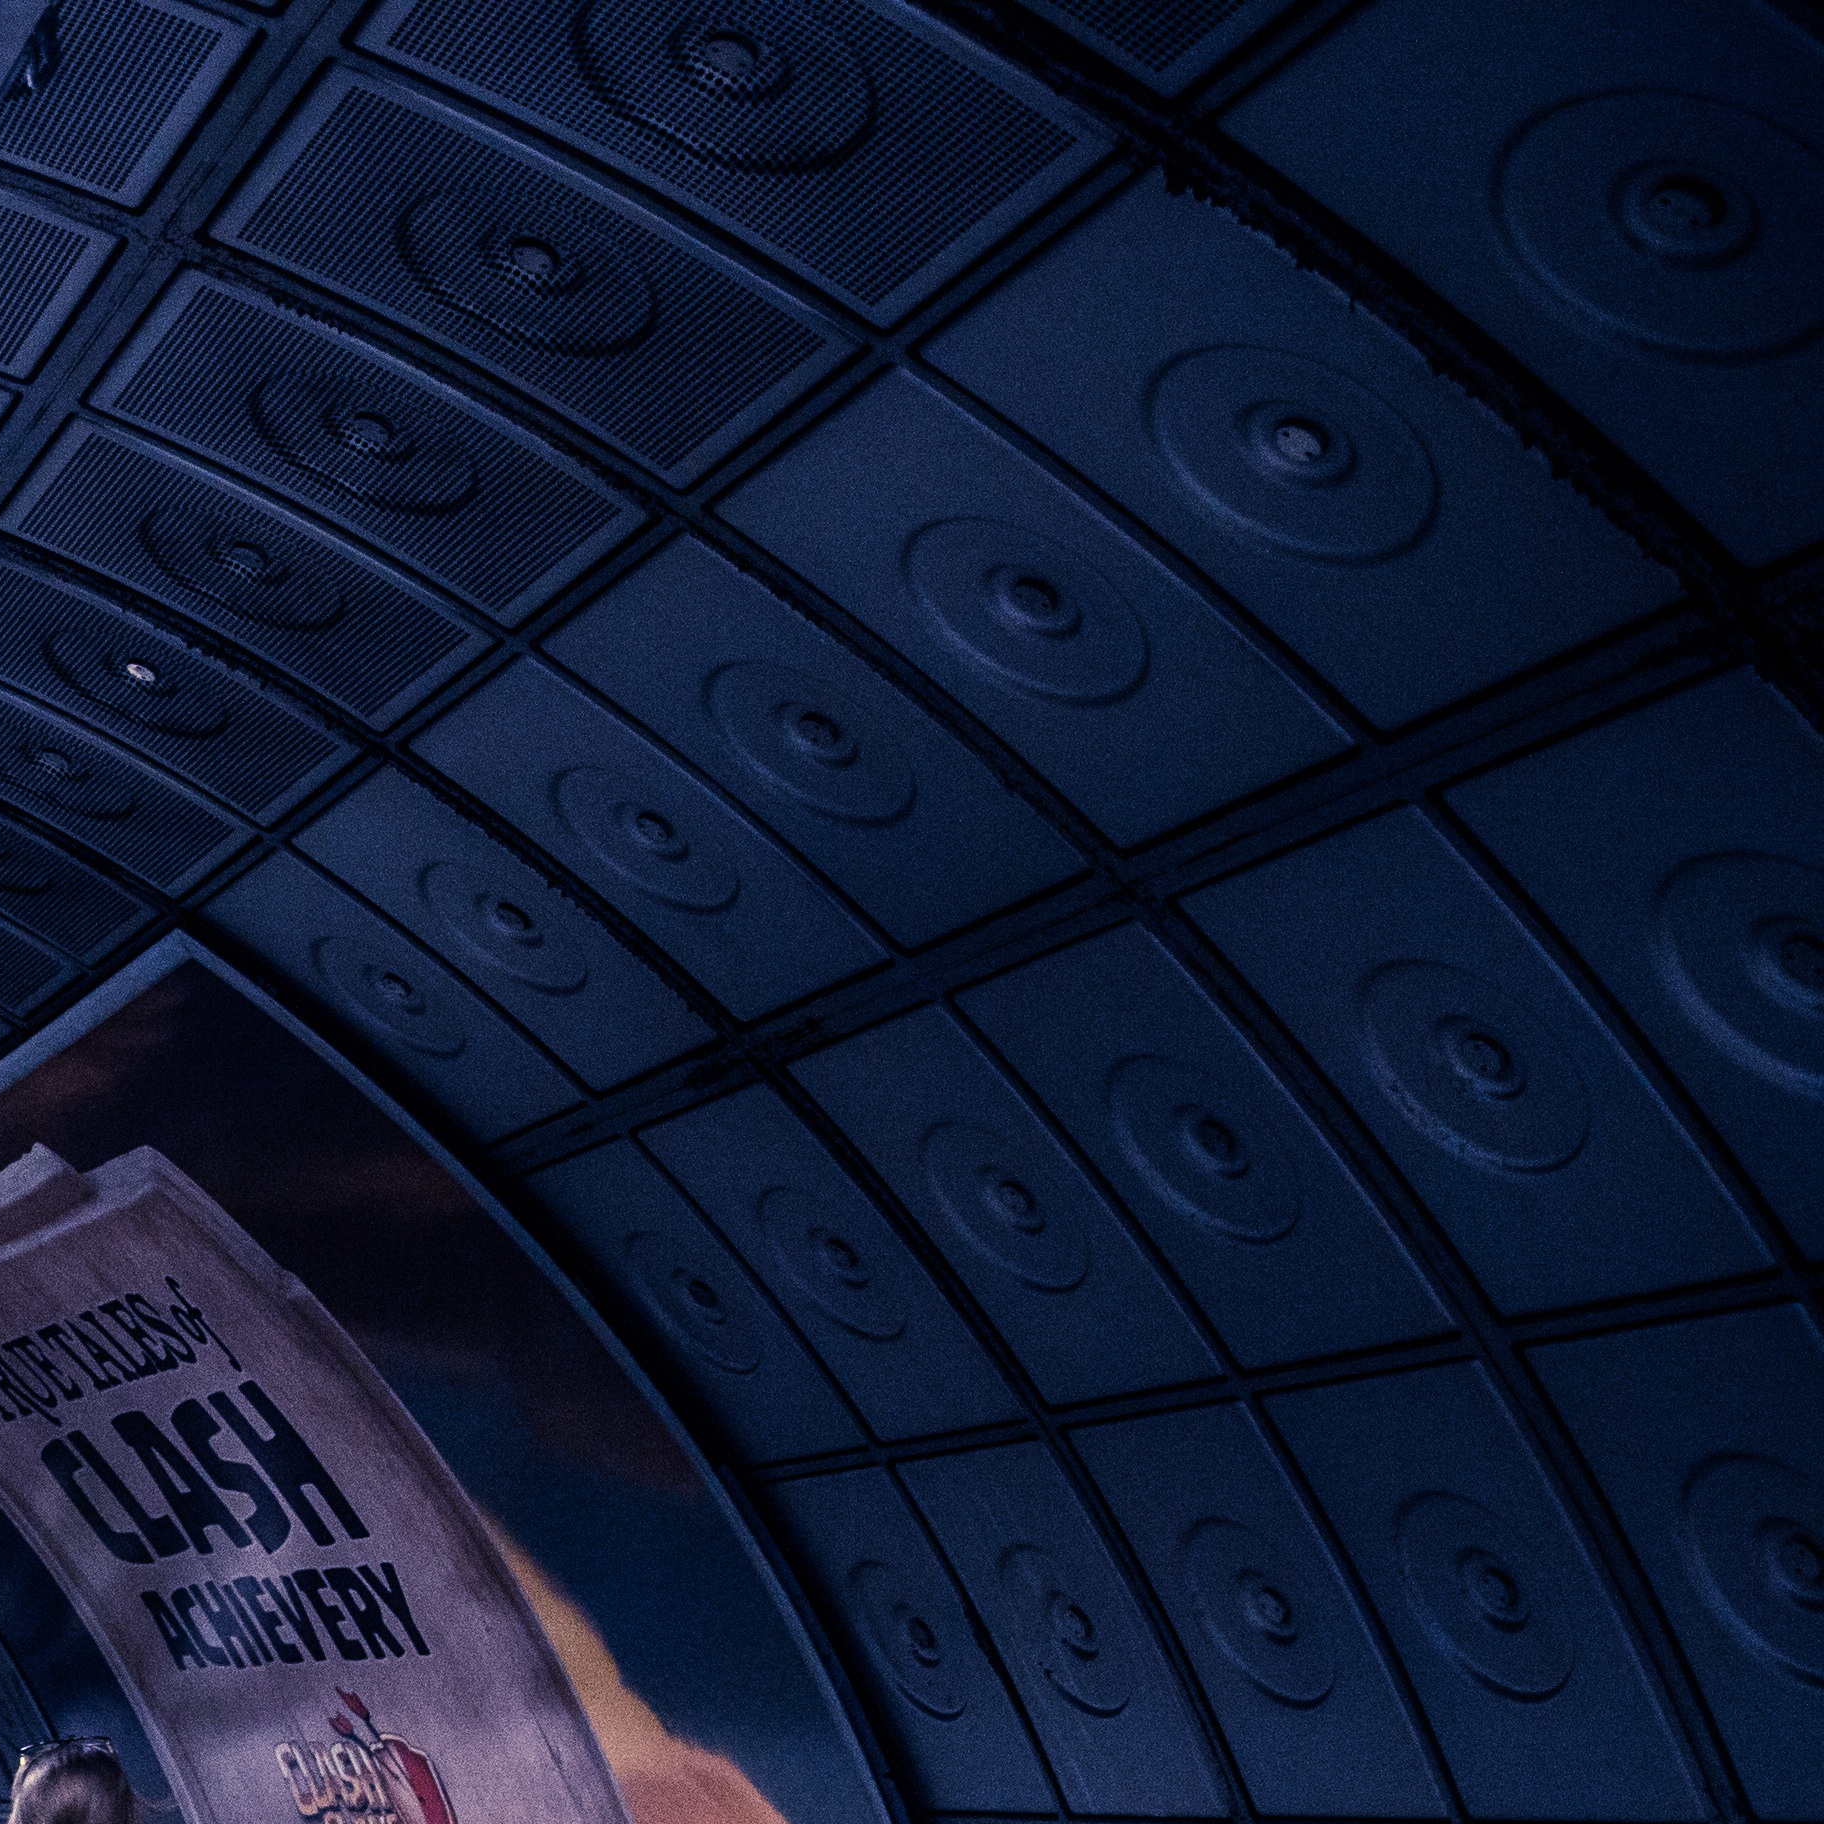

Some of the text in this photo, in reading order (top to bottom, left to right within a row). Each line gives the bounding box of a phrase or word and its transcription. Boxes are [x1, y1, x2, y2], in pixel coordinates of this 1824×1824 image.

[36, 1293, 197, 1391] TALES
[165, 1275, 242, 1373] of
[40, 1380, 370, 1566] CLASH
[141, 1560, 432, 1671] ACHIEVERY
[274, 1741, 388, 1818] CLASH
